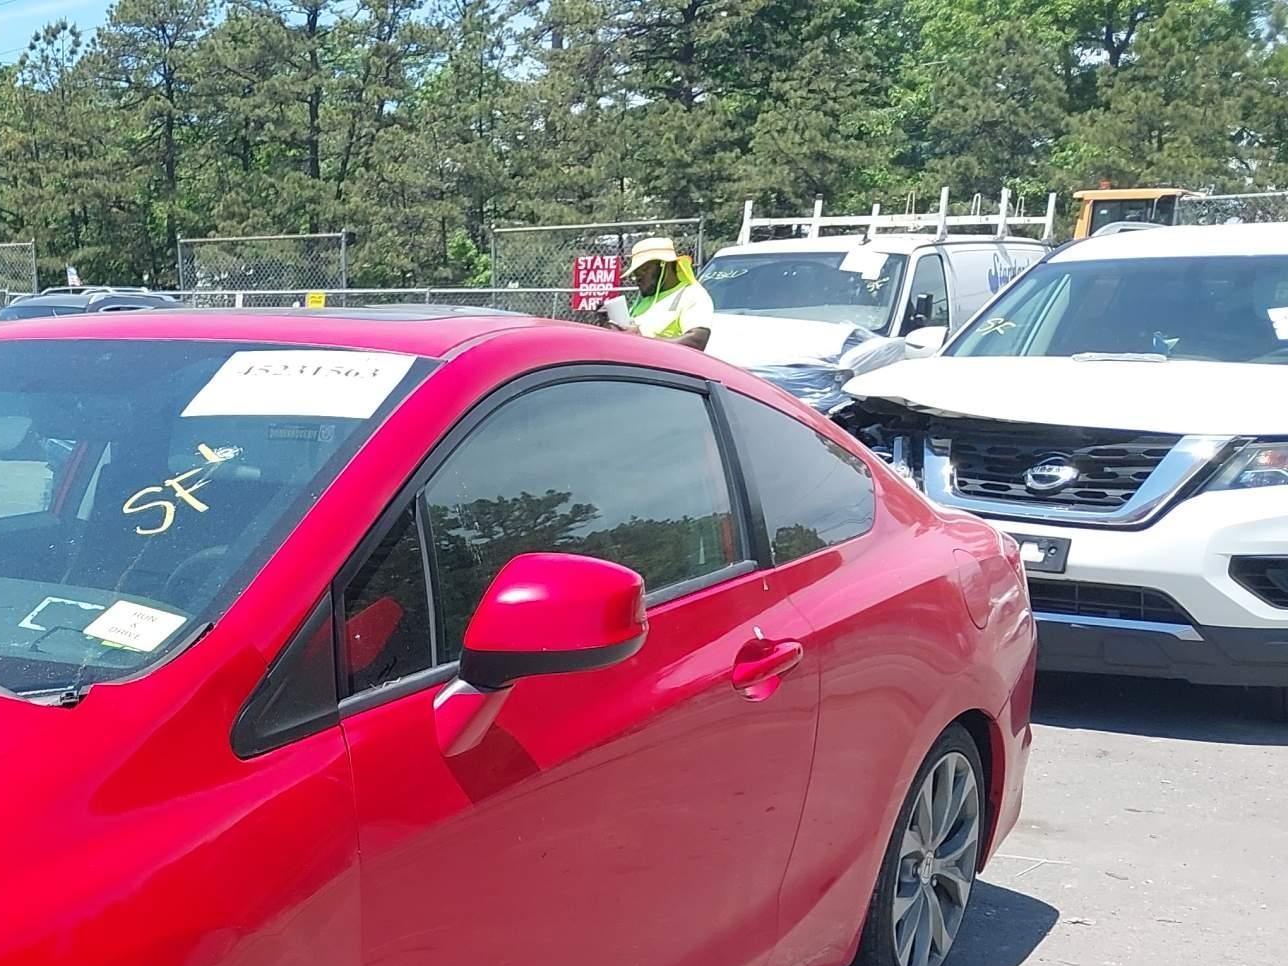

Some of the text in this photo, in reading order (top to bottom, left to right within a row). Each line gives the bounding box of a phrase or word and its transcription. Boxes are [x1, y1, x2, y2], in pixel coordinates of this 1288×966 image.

[577, 256, 617, 269] STATE
[579, 270, 615, 283] FARM
[579, 284, 613, 296] DROP
[577, 297, 609, 310] AR
[122, 467, 213, 534] SF
[133, 610, 159, 623] RUN
